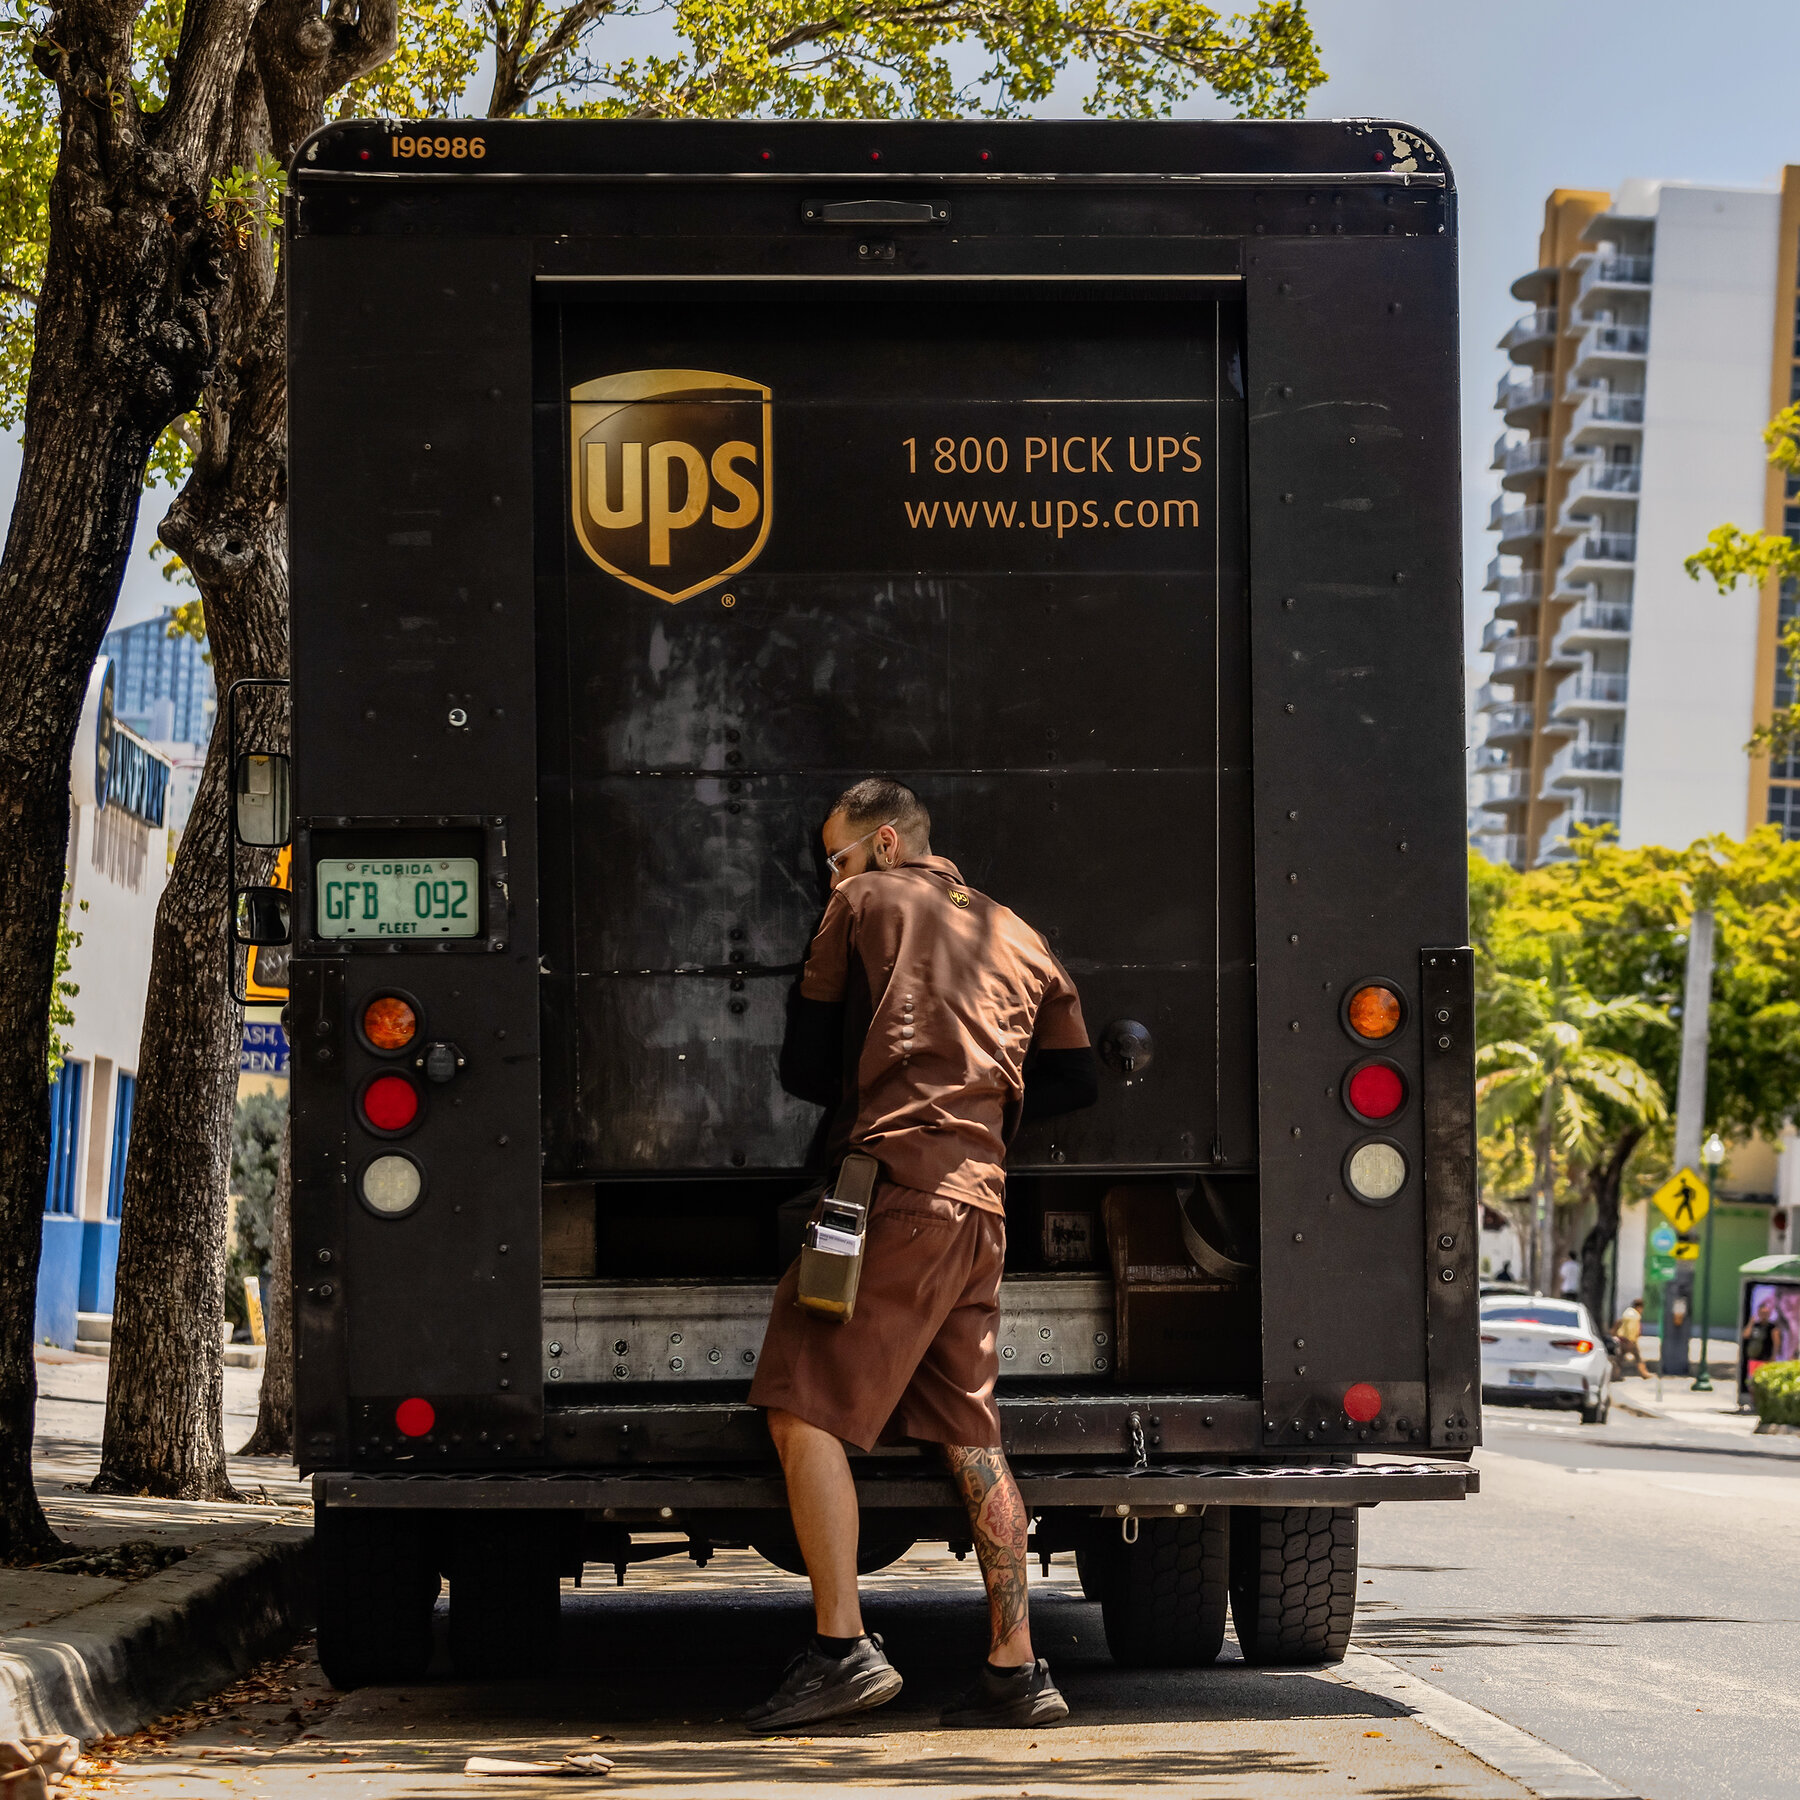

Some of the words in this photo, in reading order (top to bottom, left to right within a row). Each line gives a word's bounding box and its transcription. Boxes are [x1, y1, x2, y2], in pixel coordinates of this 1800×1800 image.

[902, 437, 916, 474] 1
[934, 436, 1009, 474] 800
[1025, 436, 1114, 474] PICK
[1129, 436, 1202, 474] UPS
[587, 440, 760, 566] ups
[904, 500, 1200, 539] www.ups.com
[361, 864, 434, 875] FLORIDA
[326, 881, 379, 920] GFB
[415, 880, 468, 919] 092
[951, 890, 969, 903] ups
[379, 922, 418, 934] FLEET
